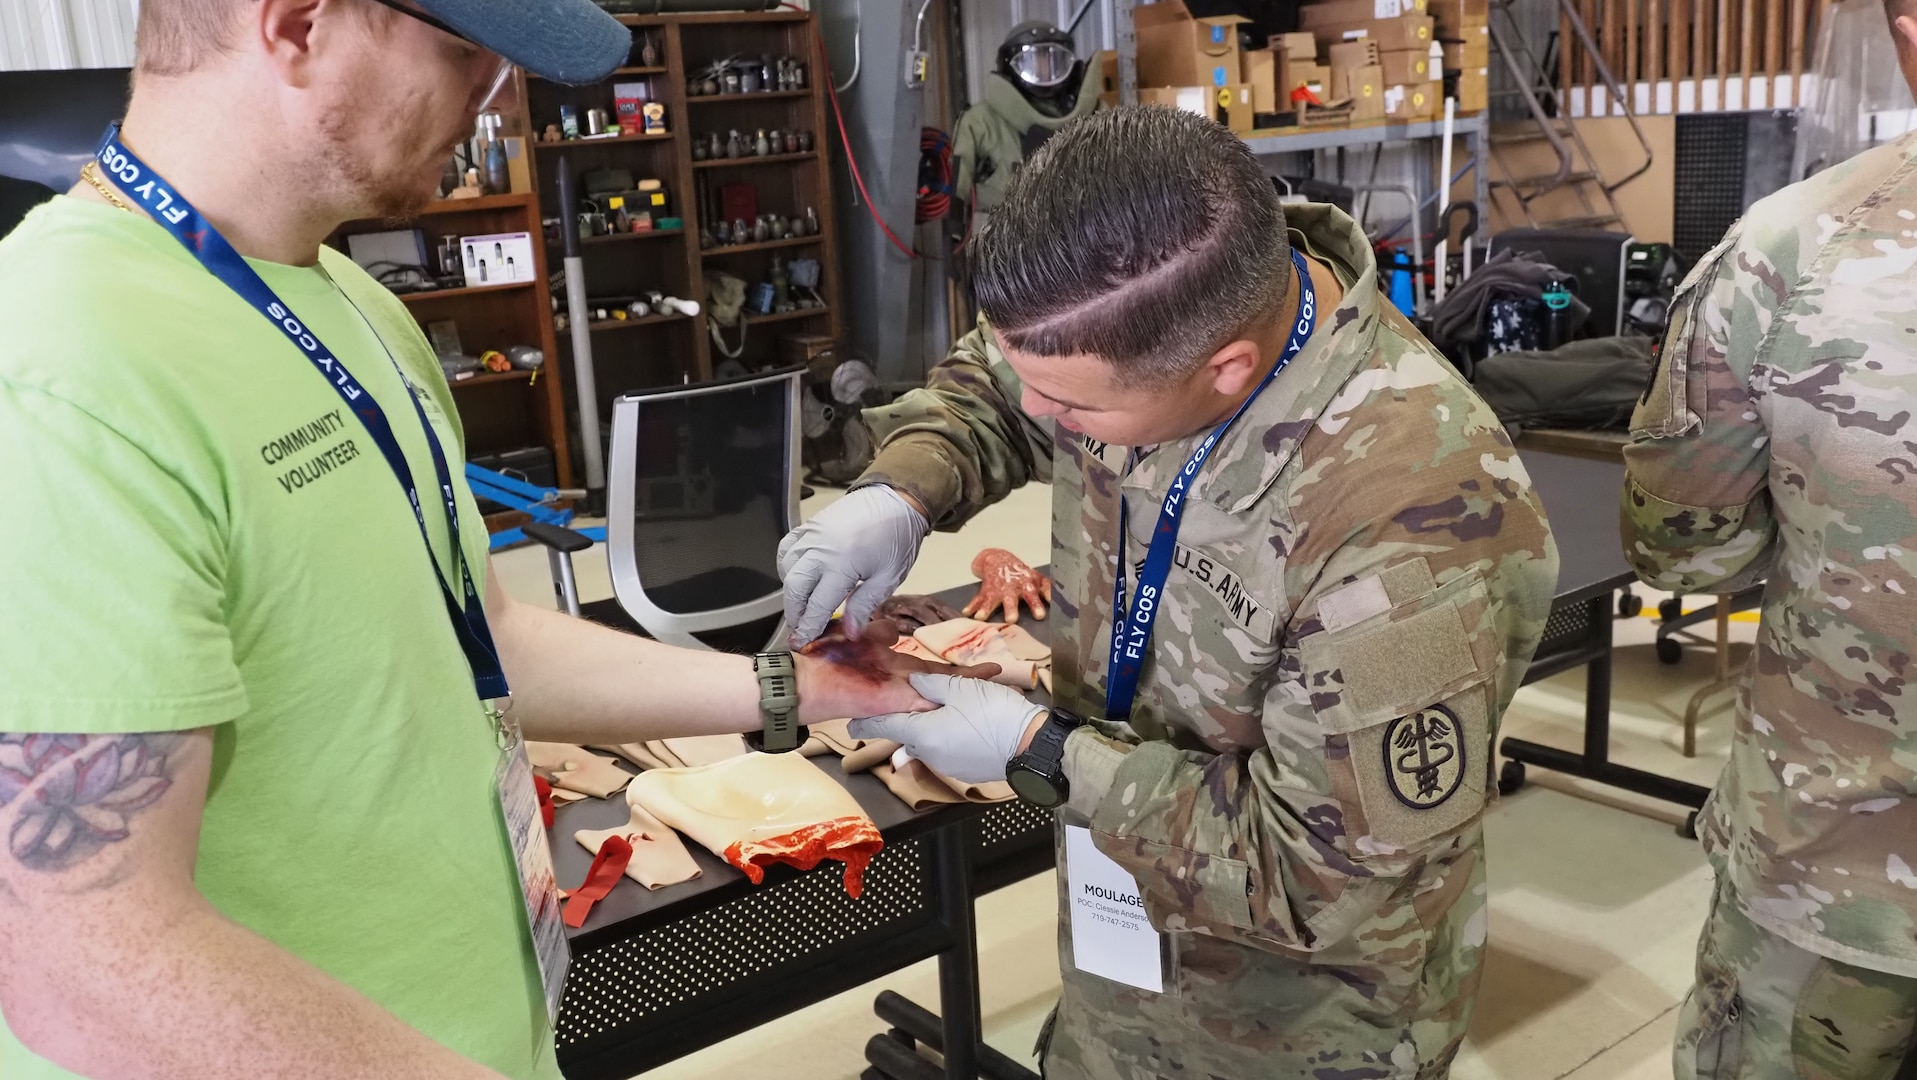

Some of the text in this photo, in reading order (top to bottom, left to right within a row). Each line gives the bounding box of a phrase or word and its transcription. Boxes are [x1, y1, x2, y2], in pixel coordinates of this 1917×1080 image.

[102, 145, 189, 225] FLY COS
[1298, 289, 1314, 336] COS
[267, 302, 362, 401] FLY COS
[261, 409, 346, 466] COMMUNITY
[277, 439, 361, 495] VOLUNTEER
[1164, 435, 1215, 518] FLY COS
[1116, 576, 1127, 615] FLY
[1174, 545, 1258, 628] U.S. ARMY
[1126, 584, 1157, 660] FLY COS
[1077, 897, 1095, 909] POC:
[1084, 884, 1144, 908] MOULAGE
[1091, 912, 1140, 931] 719-747-2575
